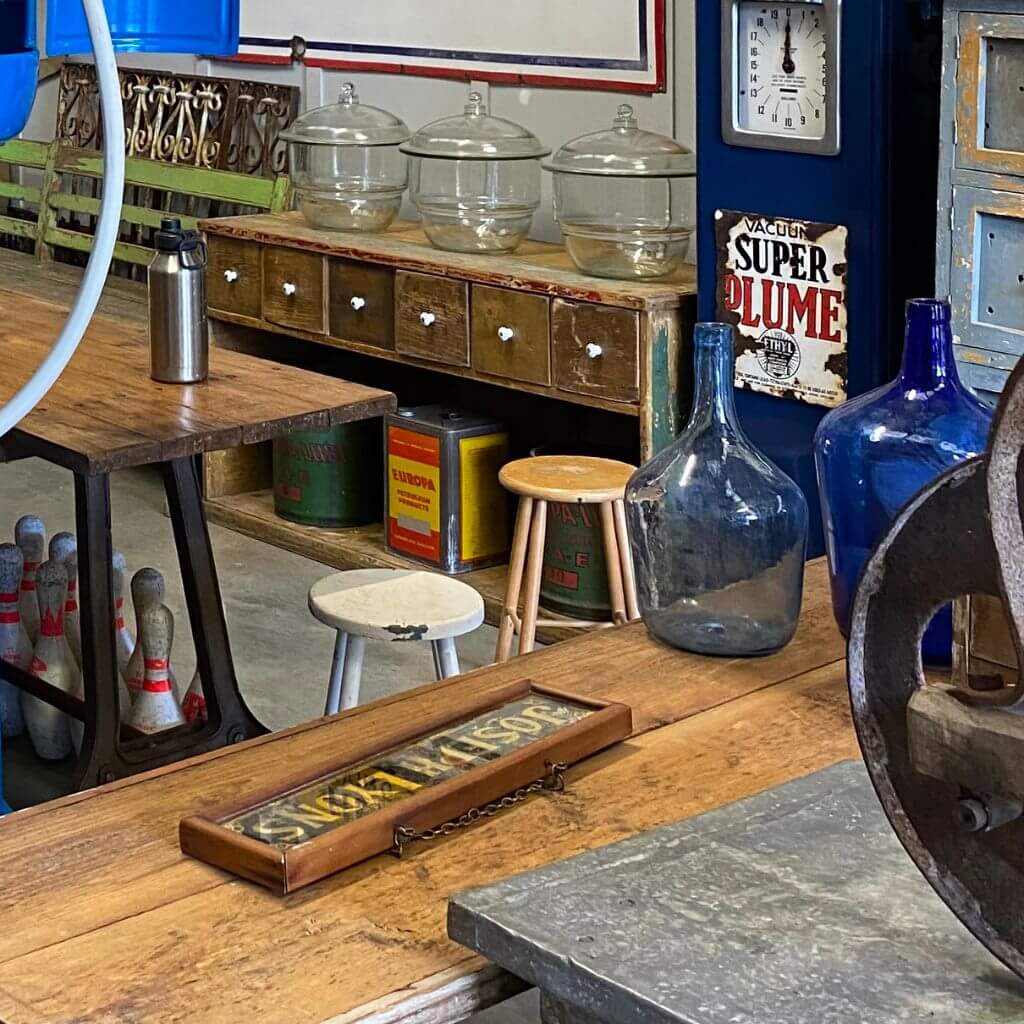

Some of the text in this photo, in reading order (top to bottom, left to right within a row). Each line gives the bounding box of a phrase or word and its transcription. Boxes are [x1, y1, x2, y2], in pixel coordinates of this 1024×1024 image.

[750, 31, 757, 41] 17
[758, 106, 765, 115] 12
[734, 233, 830, 284] SUPER
